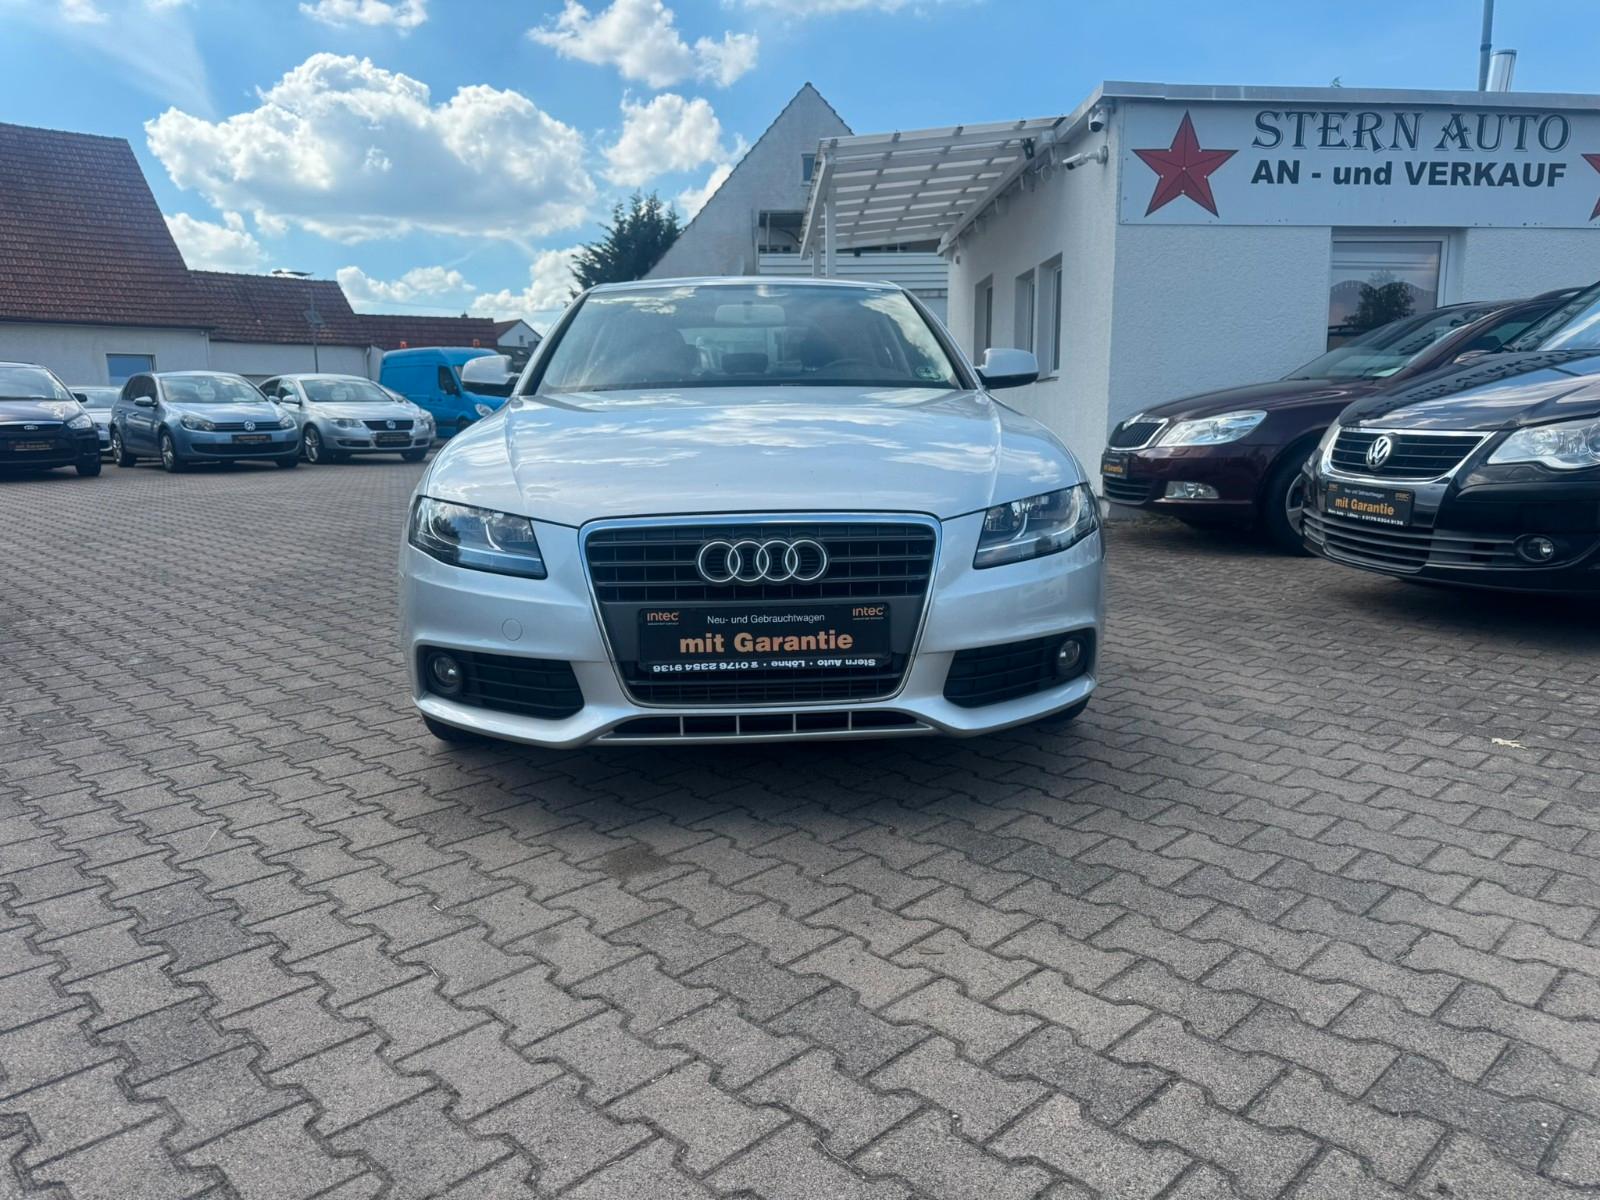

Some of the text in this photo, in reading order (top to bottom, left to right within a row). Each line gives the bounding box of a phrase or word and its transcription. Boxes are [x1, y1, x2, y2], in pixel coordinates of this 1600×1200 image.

[1251, 110, 1571, 153] STERN AUTO
[1251, 159, 1300, 185] AN
[1332, 160, 1393, 186] und
[1404, 161, 1567, 188] VERKAUF
[1335, 496, 1395, 516] mit Garantie
[707, 613, 825, 624] Neu- und Gebrauchtwagen
[679, 629, 853, 653] mit Garantie
[817, 658, 842, 667] Auto
[845, 658, 876, 667] Stern
